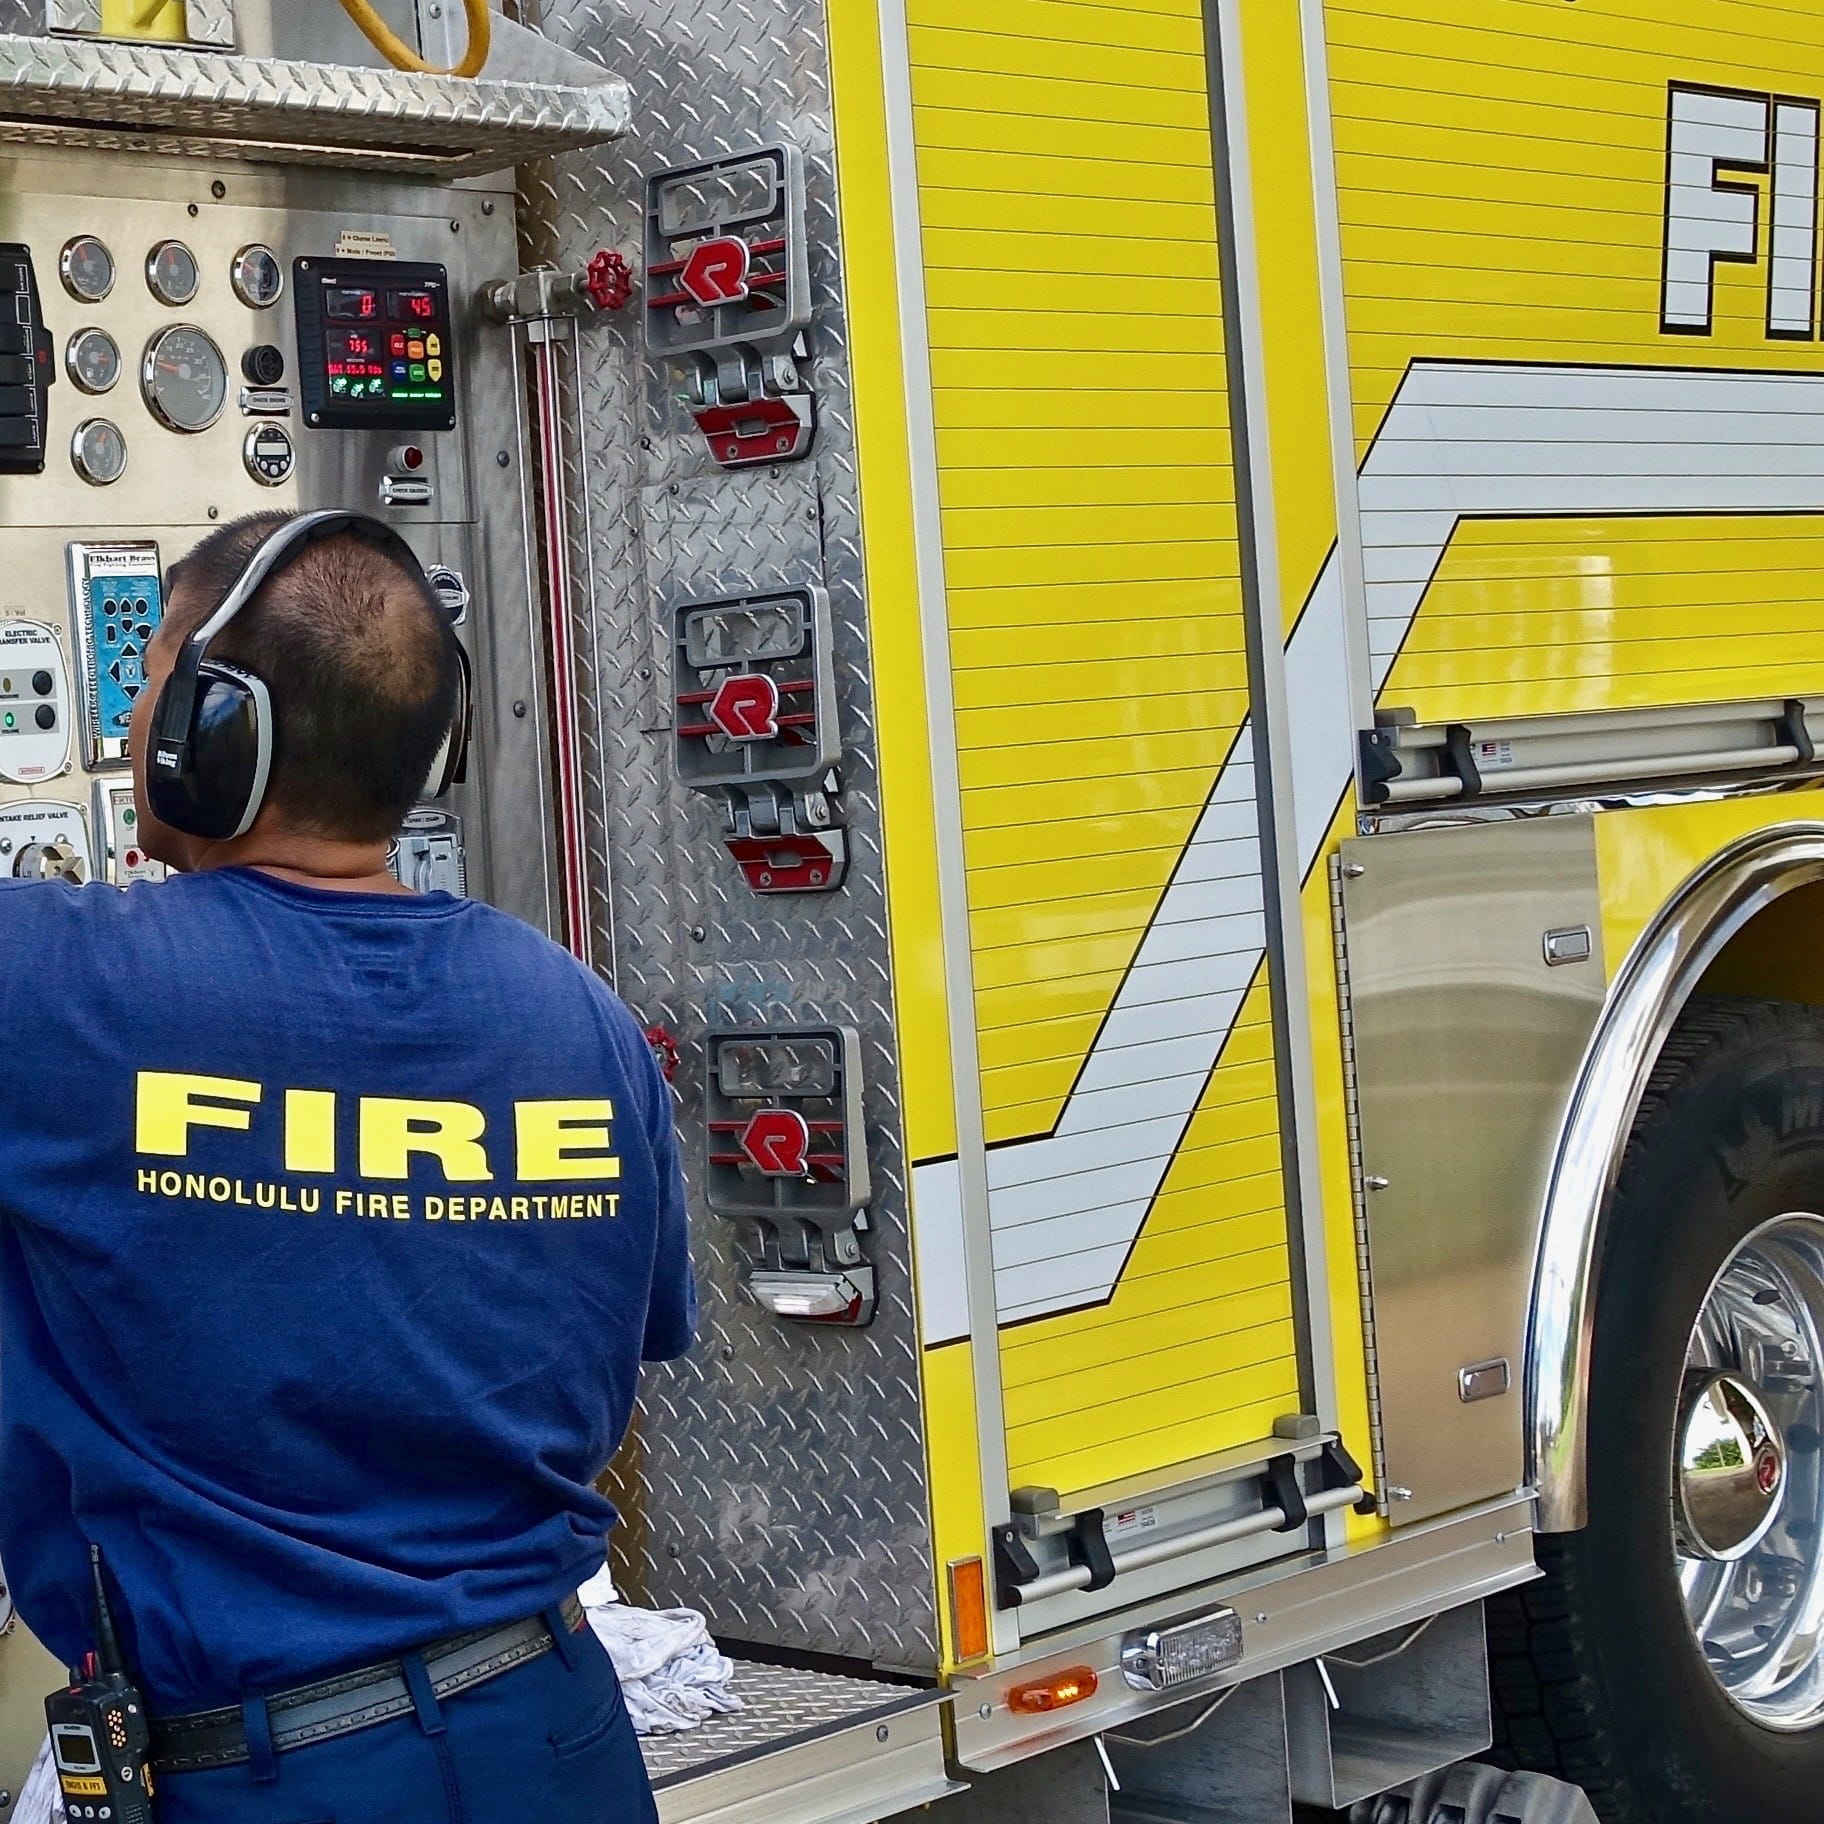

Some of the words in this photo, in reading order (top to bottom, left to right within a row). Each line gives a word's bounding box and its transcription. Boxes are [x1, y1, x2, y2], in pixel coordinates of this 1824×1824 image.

[1658, 78, 1824, 342] FI
[410, 296, 432, 317] 45
[89, 554, 127, 564] Elkhart
[129, 554, 156, 564] Brass
[4, 630, 38, 638] ELECTRIC
[28, 636, 52, 644] VALVE
[22, 812, 46, 822] RELIEF
[46, 811, 68, 820] VALVE
[135, 1070, 622, 1181] FIRE
[137, 1169, 319, 1214] HONOLULU
[334, 1190, 412, 1221] FIRE
[424, 1192, 620, 1221] DEPARTMENT
